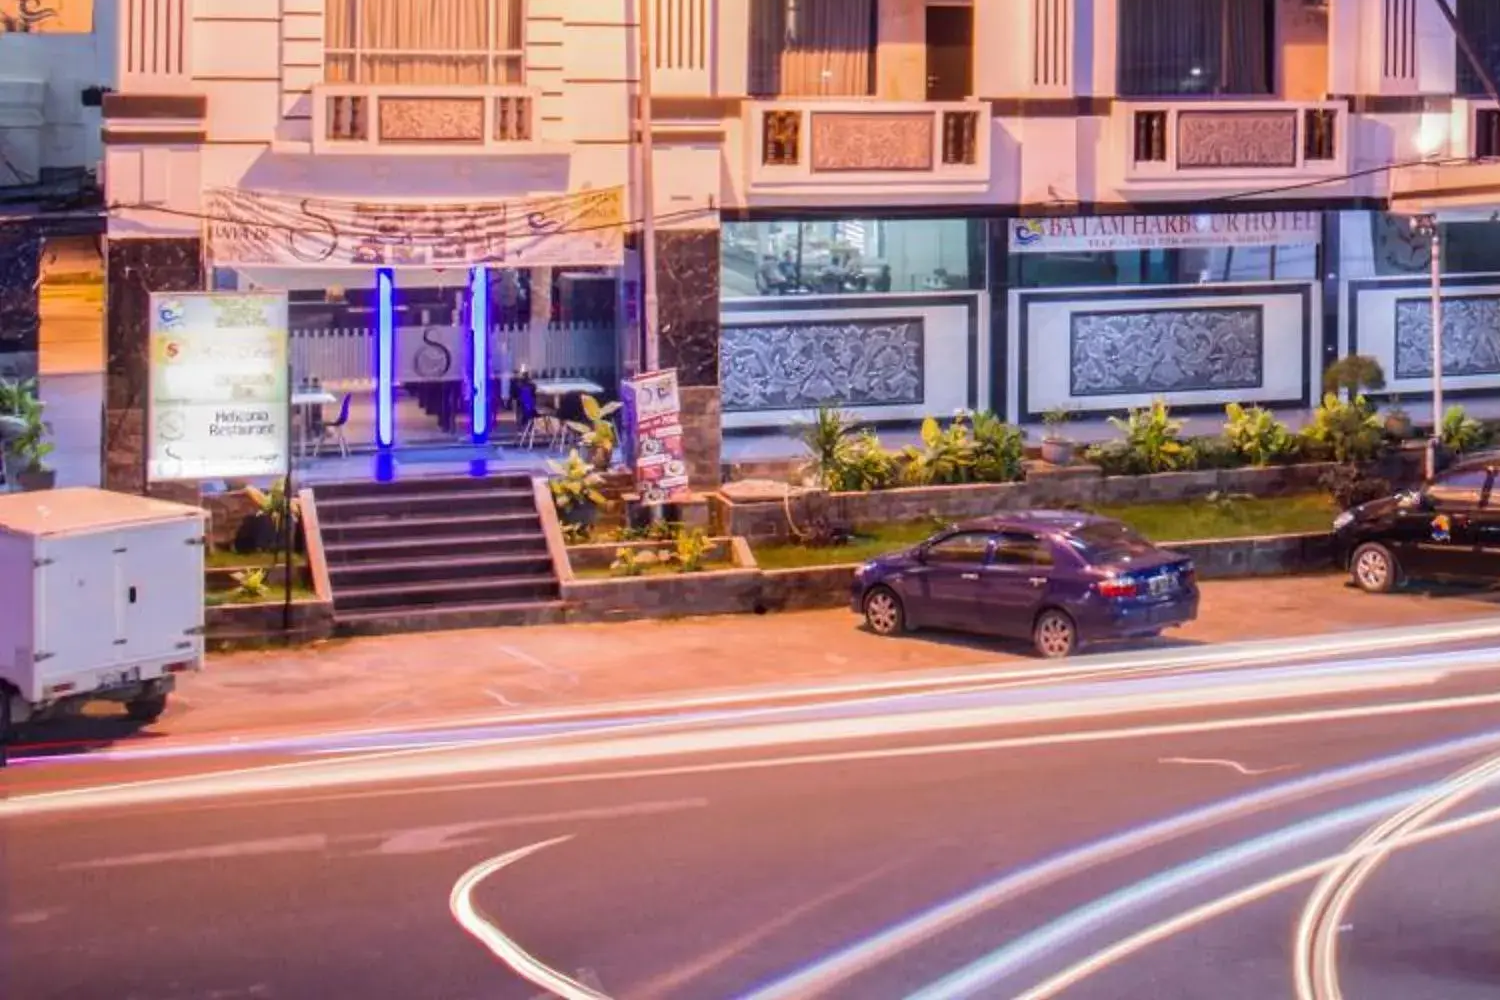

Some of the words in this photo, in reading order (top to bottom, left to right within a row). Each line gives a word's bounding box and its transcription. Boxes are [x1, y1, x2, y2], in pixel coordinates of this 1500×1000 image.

[1050, 215, 1126, 237] BATAM
[1245, 211, 1316, 231] HOTEL
[208, 423, 274, 437] Restaurant
